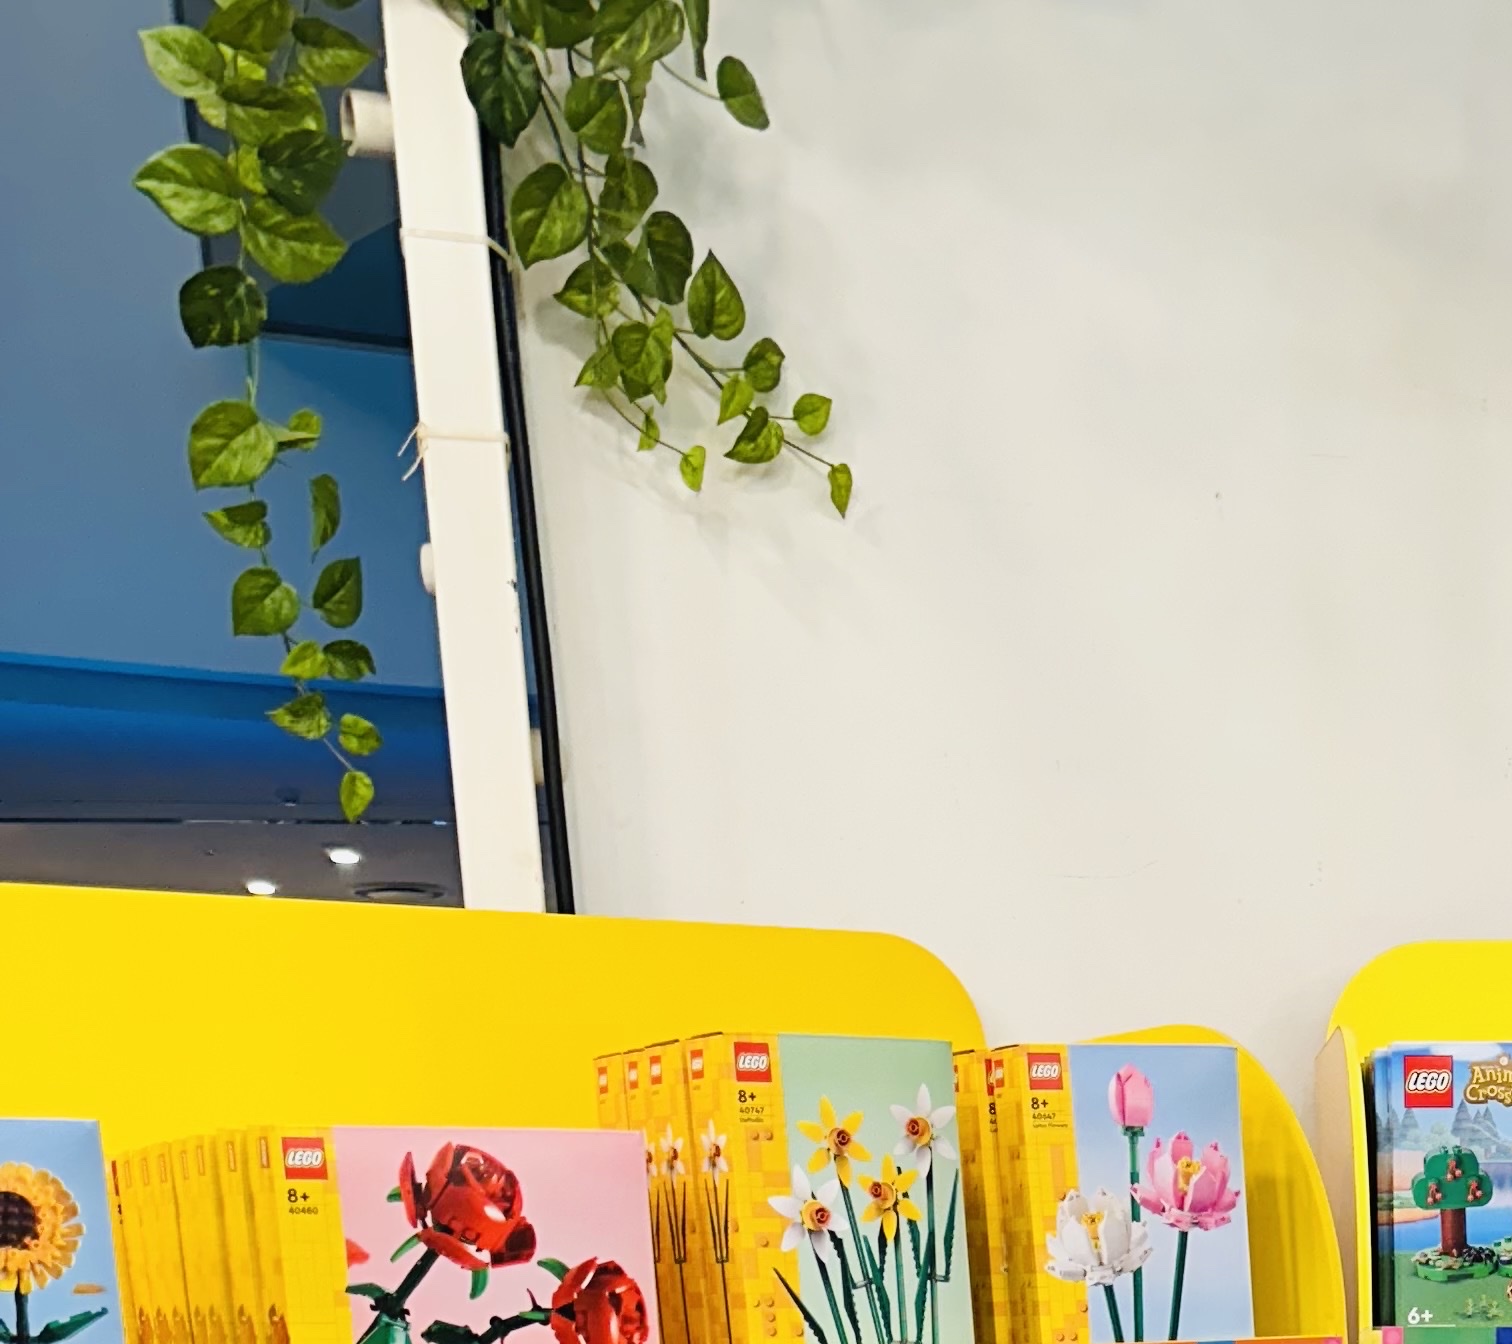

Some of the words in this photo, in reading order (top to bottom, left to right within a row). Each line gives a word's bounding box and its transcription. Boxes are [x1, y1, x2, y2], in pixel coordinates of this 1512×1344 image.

[738, 1053, 768, 1071] LEGO
[1032, 1064, 1059, 1078] LEGO
[738, 1090, 756, 1103] 8+
[1032, 1098, 1048, 1109] 8+
[286, 1148, 324, 1167] LEGO
[287, 1188, 310, 1205] 8+
[1408, 1307, 1433, 1325] 6+
